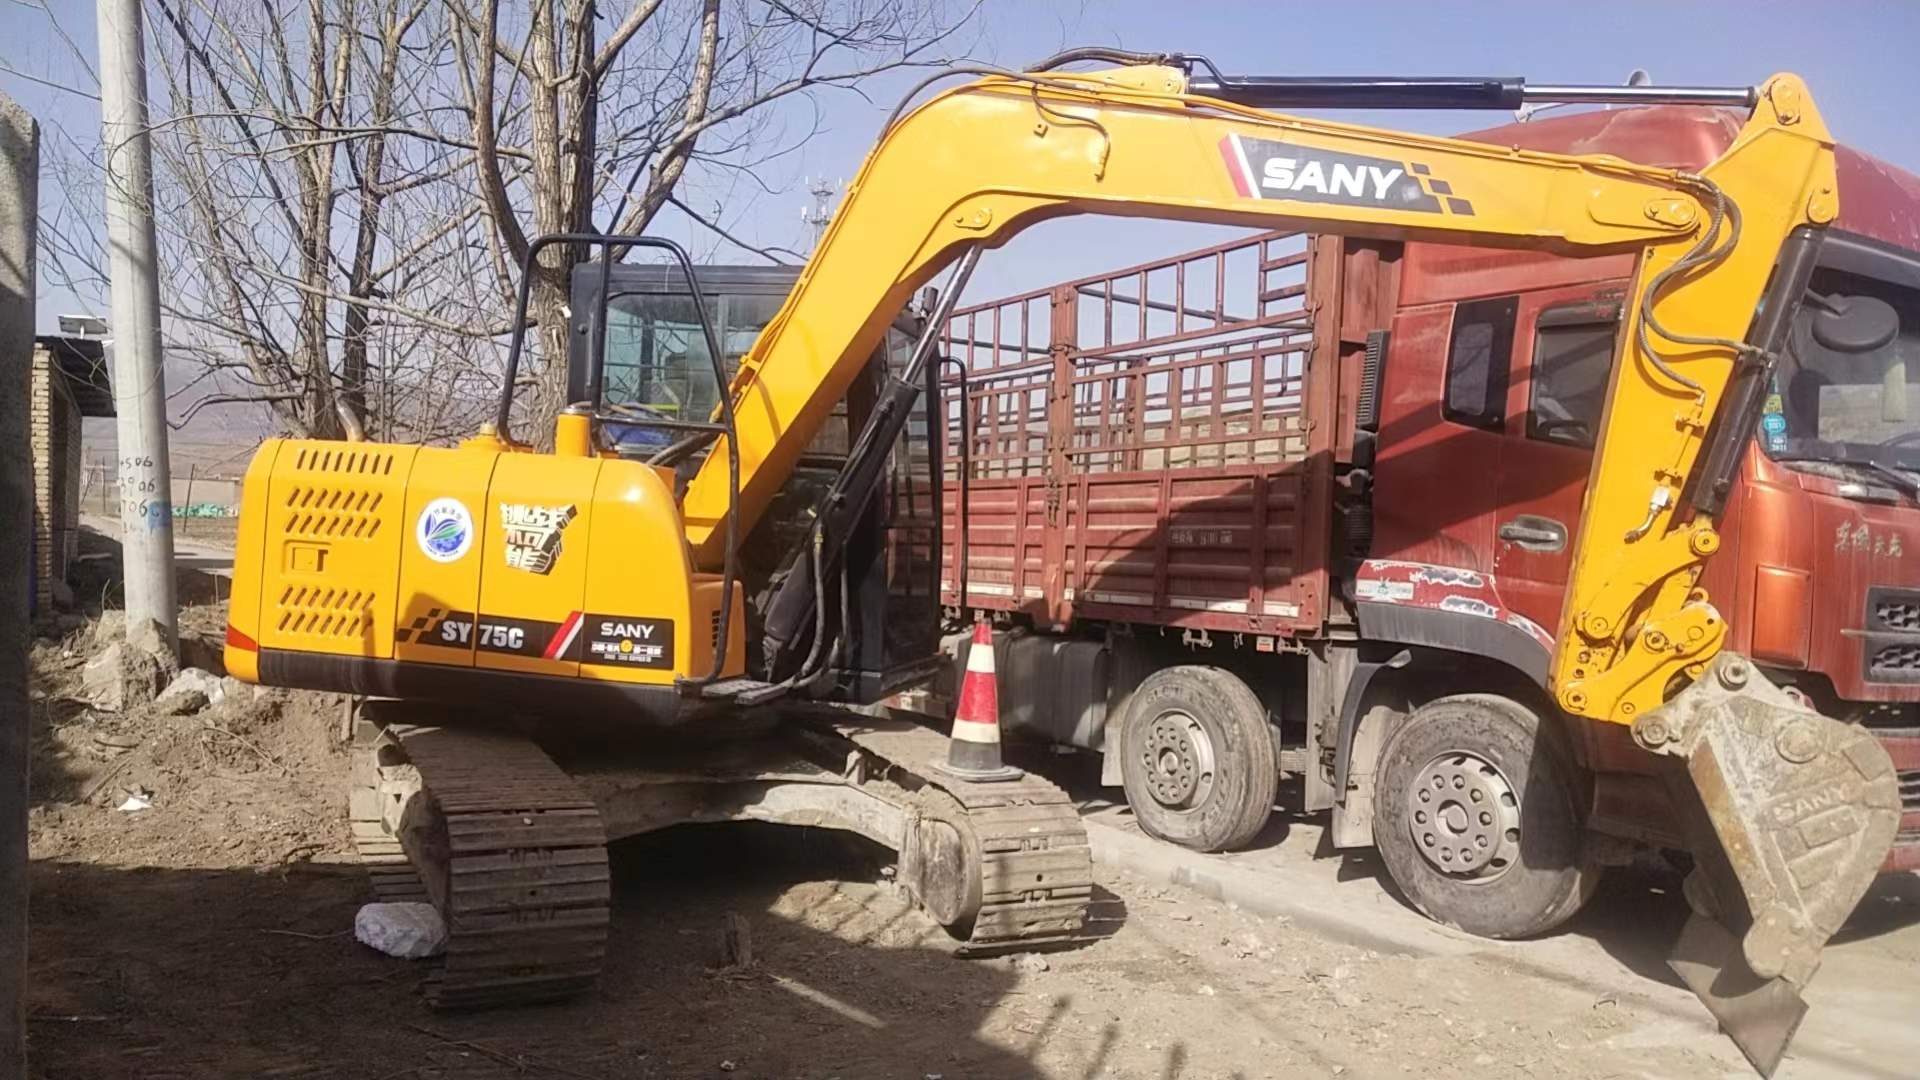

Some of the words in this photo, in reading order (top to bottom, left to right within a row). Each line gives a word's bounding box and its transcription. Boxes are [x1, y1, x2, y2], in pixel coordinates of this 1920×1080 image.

[1261, 157, 1404, 200] SANY
[479, 624, 524, 649] 75C
[600, 622, 654, 639] SANY
[1772, 782, 1852, 822] SANY
